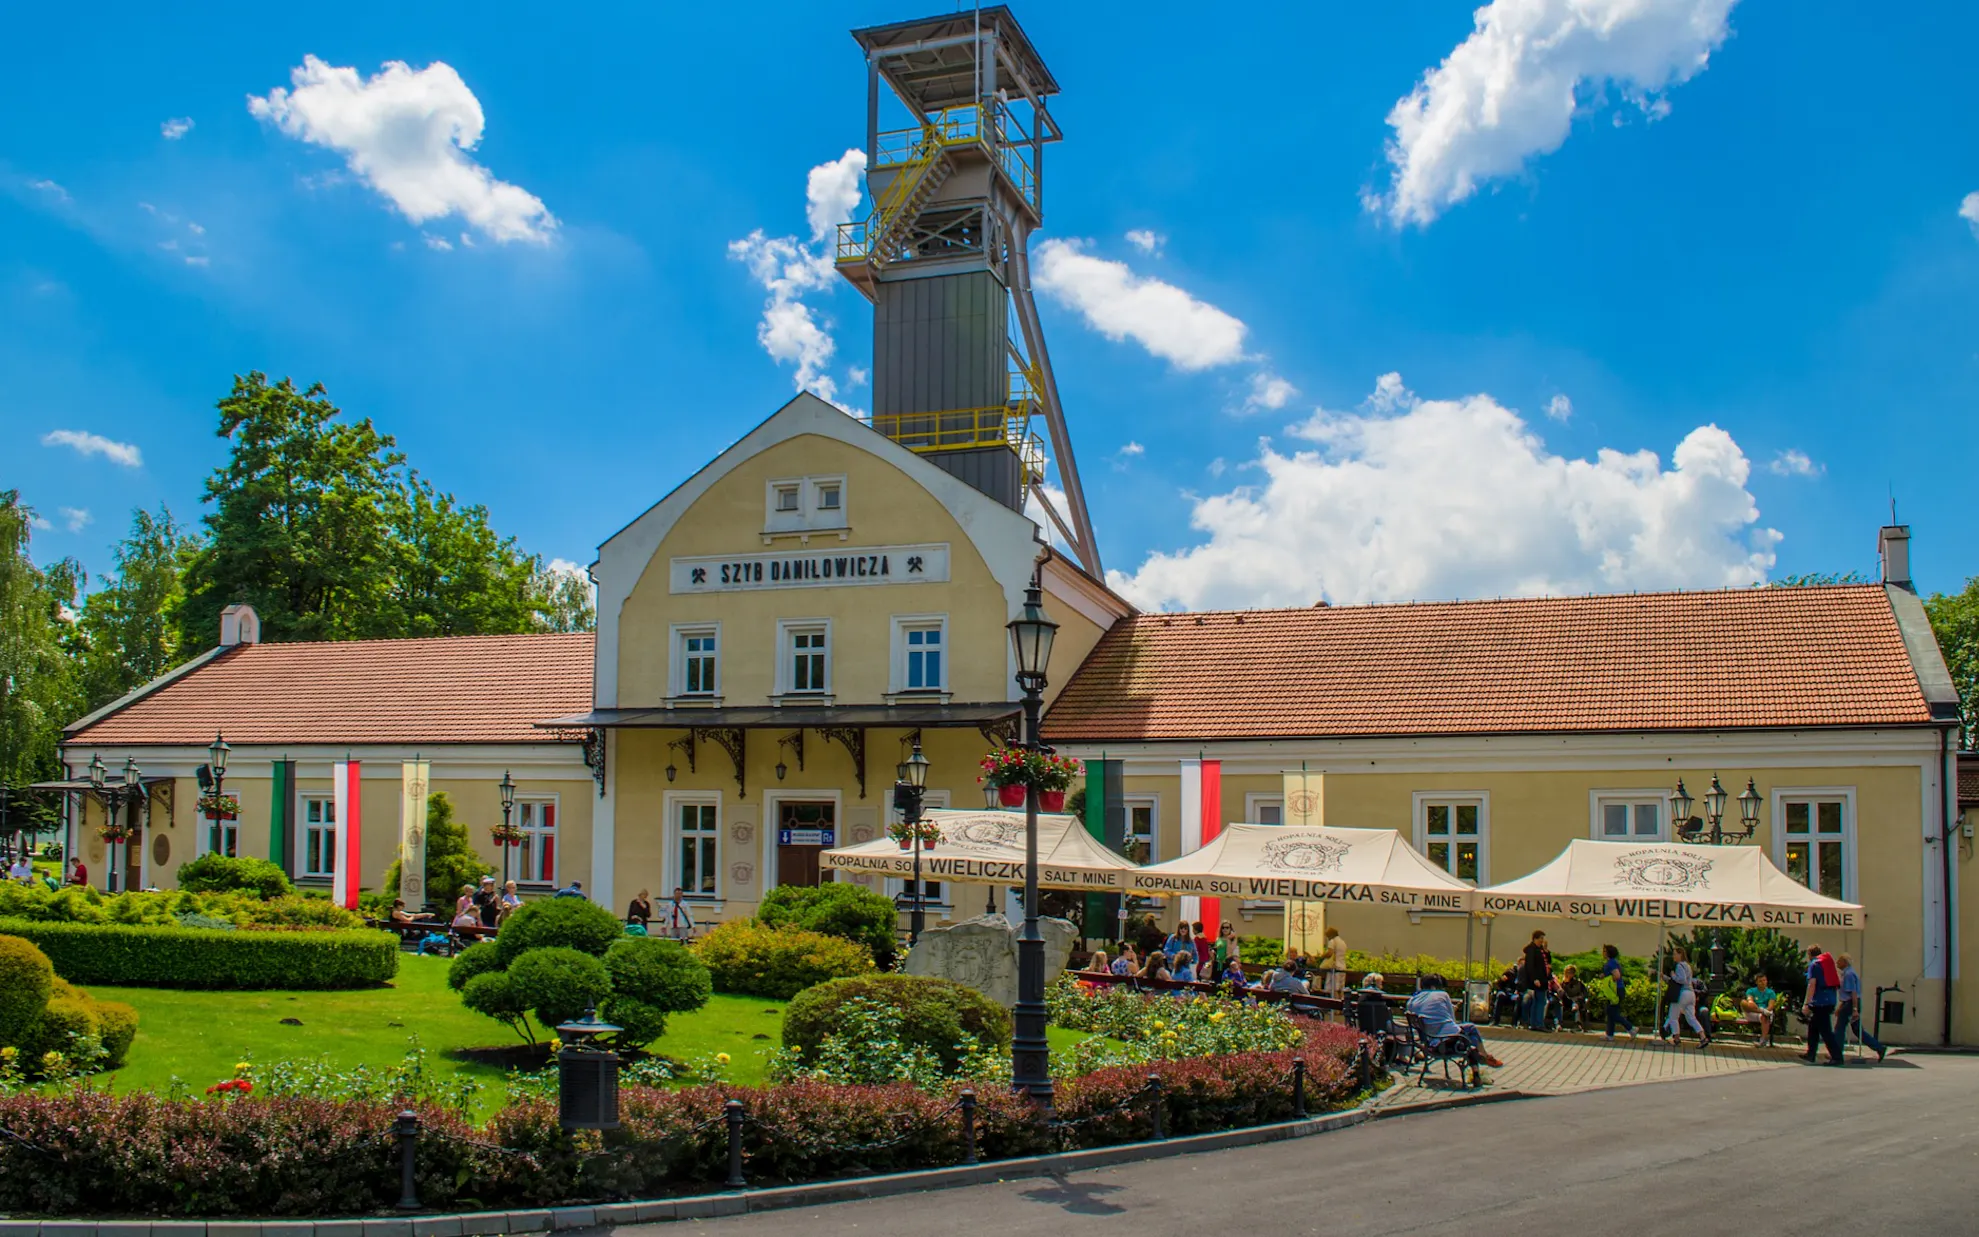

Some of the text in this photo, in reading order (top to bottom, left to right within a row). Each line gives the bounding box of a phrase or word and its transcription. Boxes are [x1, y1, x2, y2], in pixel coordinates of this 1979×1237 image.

[721, 555, 889, 583] SZYB DANIŁOWICZA
[829, 855, 1116, 885] KOPALNIA SOI WIELICZK SALT MINE
[1134, 876, 1461, 908] KOPALNIA SOLI WIELICZKA SALT MINE
[1484, 897, 1854, 926] KOPALNIA SOLI WIELICZKA SALT MINE
